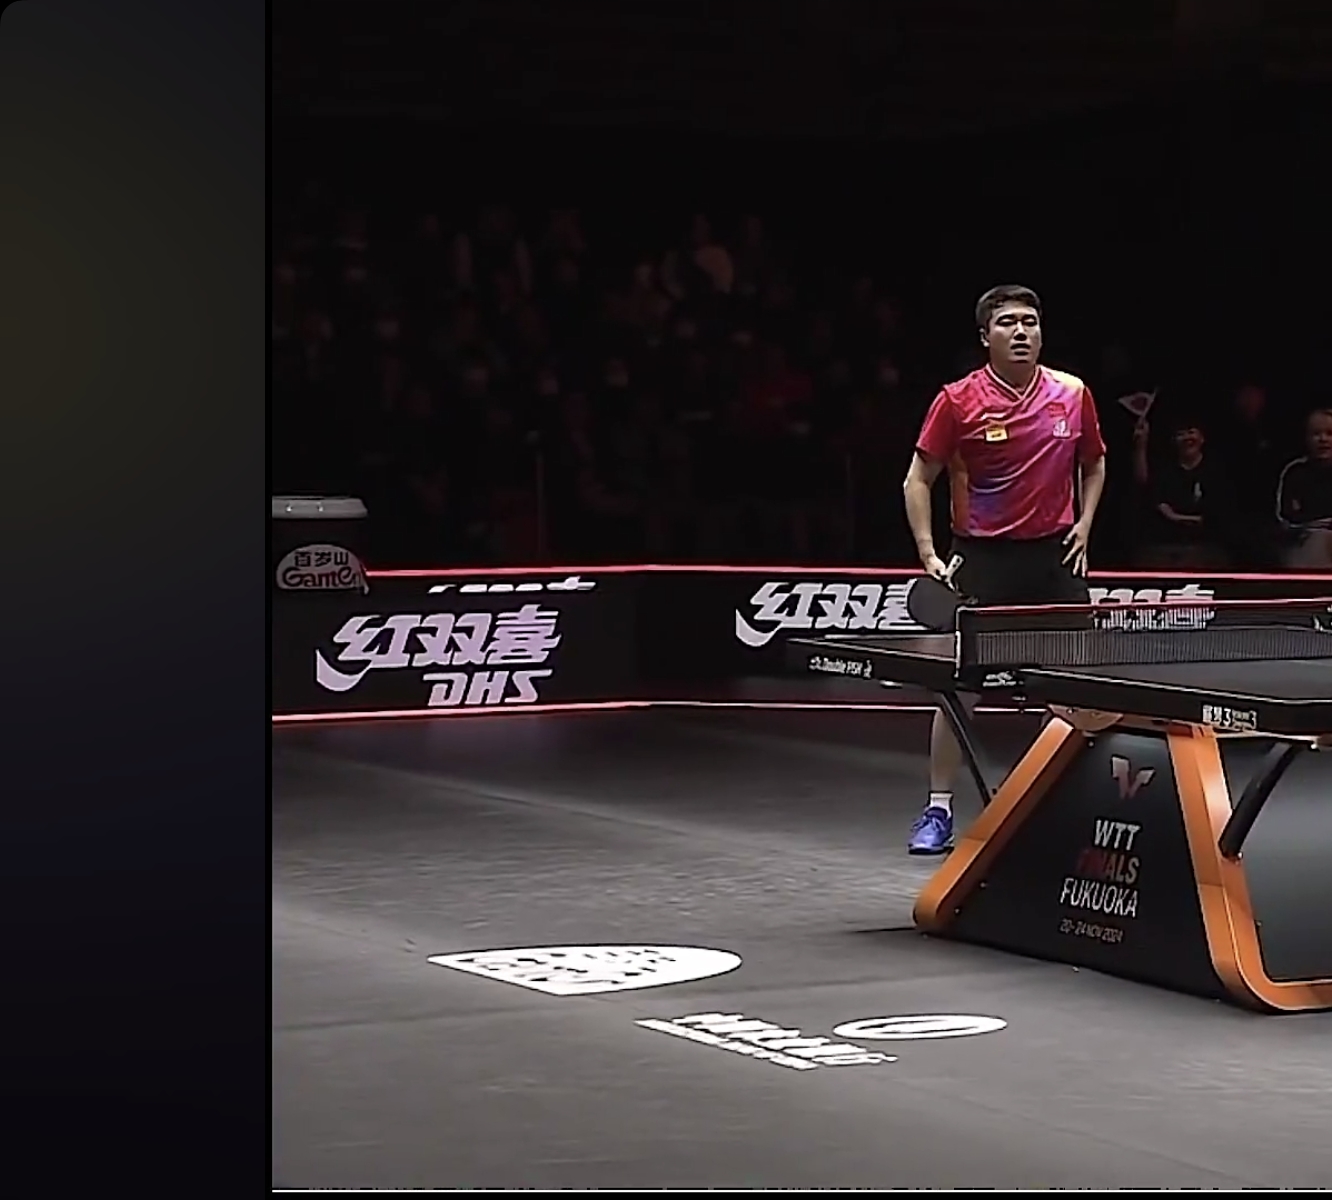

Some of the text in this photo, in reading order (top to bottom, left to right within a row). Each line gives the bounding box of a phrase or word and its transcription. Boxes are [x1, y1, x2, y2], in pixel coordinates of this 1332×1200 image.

[294, 551, 349, 567] 百岁山
[315, 604, 563, 692] 红双喜
[422, 668, 554, 707] DHS
[1094, 819, 1141, 851] WTT
[1059, 877, 1139, 918] FUKUOKA
